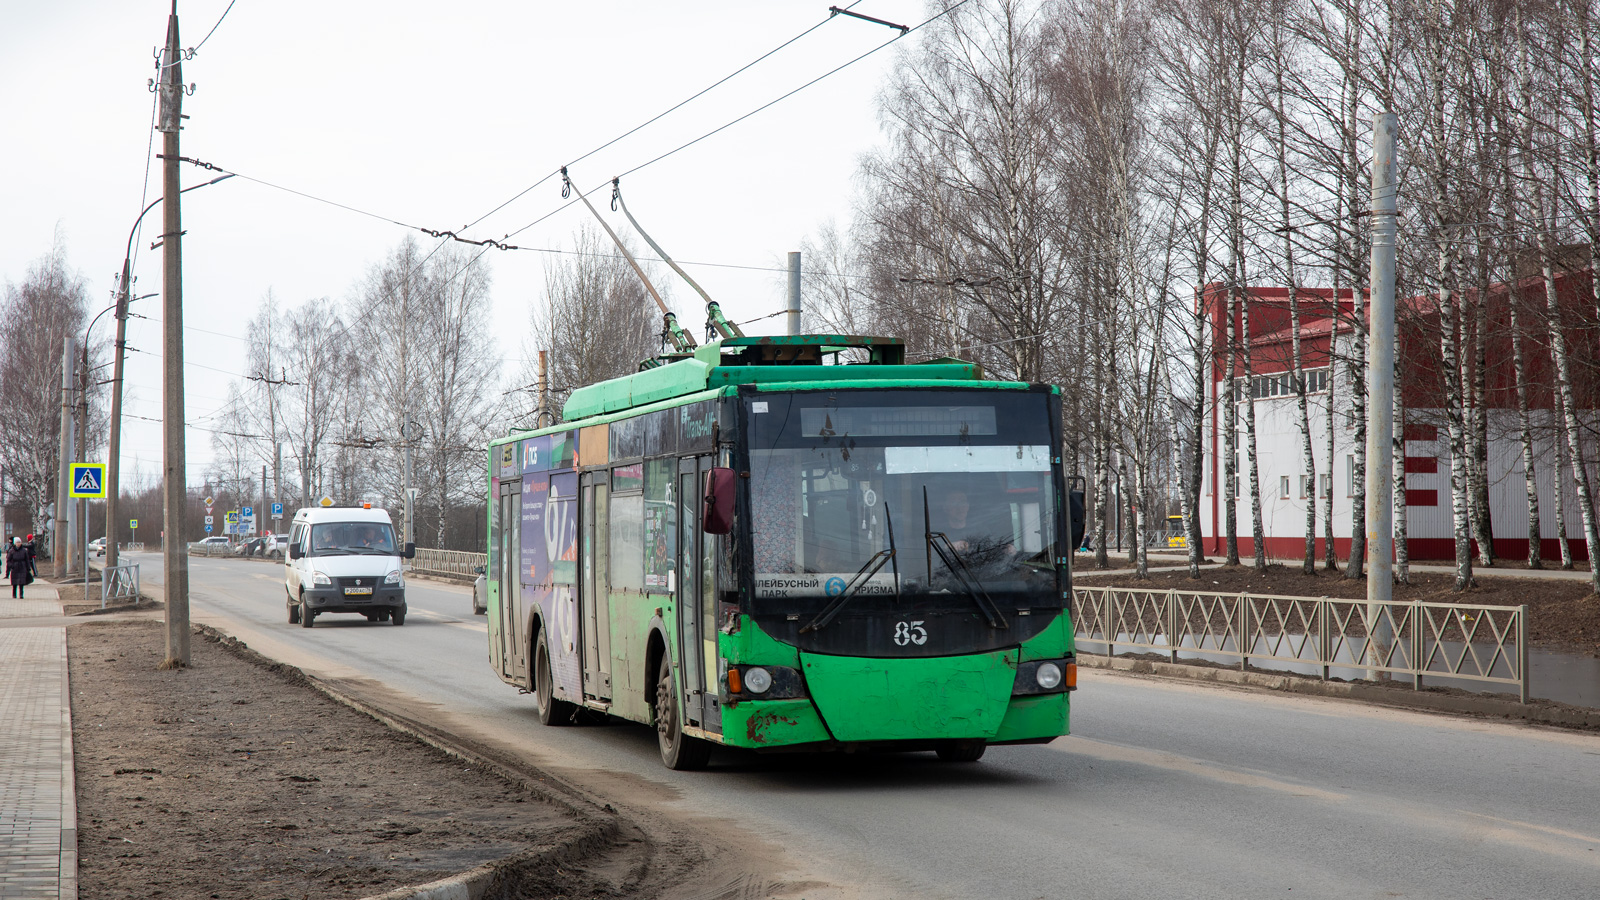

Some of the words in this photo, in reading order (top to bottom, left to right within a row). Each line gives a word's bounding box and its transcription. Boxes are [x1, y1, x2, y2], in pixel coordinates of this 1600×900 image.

[754, 578, 819, 588] ЛЕЙБУСНЫЙ
[761, 589, 789, 598] ПАРК
[893, 620, 928, 646] 85
